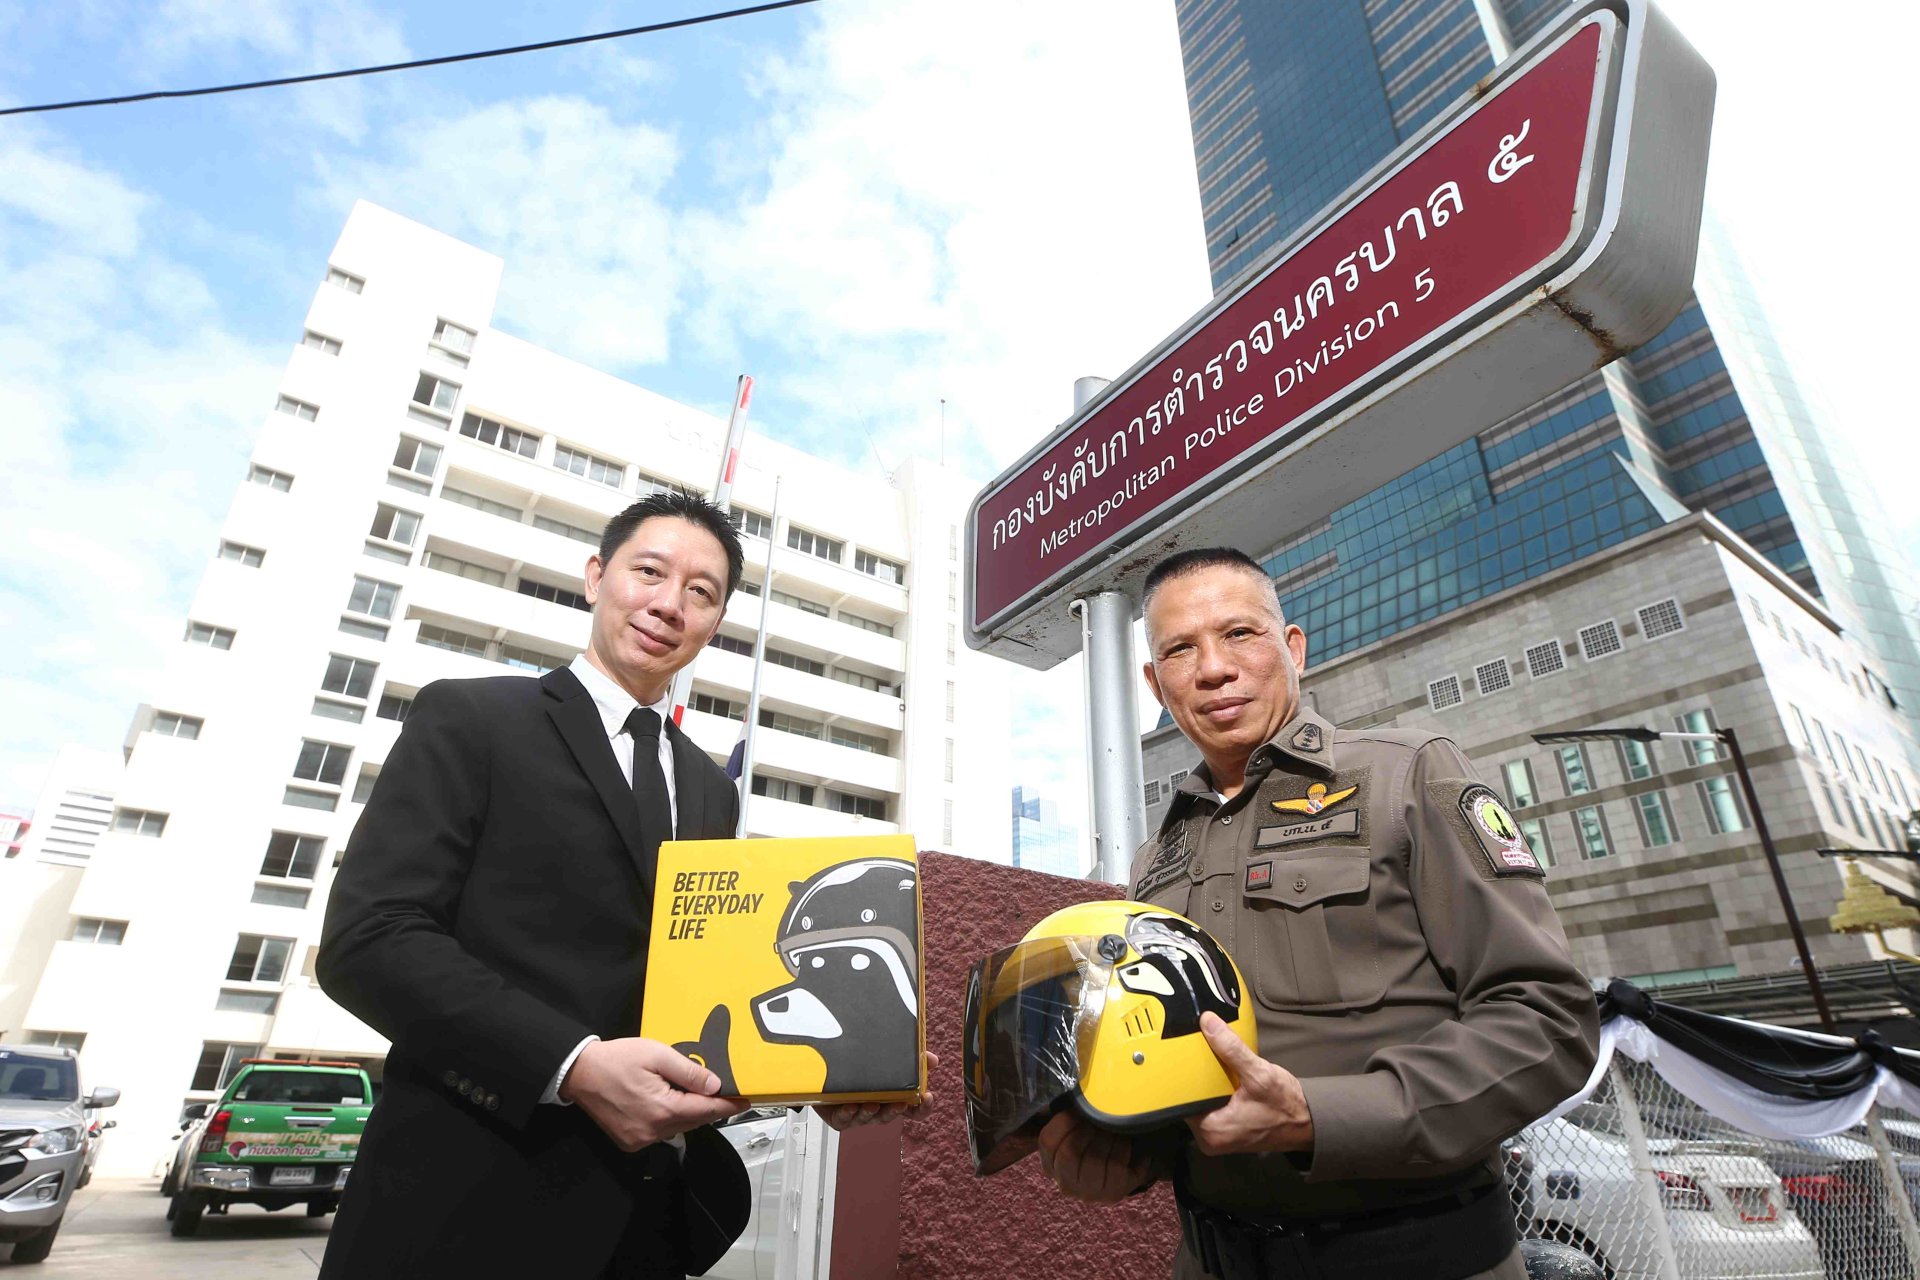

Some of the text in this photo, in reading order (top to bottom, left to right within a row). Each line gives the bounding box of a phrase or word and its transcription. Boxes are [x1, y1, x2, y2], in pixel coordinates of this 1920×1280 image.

[992, 118, 1535, 551] กองบังคับการตำรวจนครบาล ๕
[1040, 267, 1435, 559] Metropolitan Police Division 5
[673, 870, 740, 893] BETTER
[670, 893, 764, 916] EVERYDAY
[668, 918, 707, 940] LIFE
